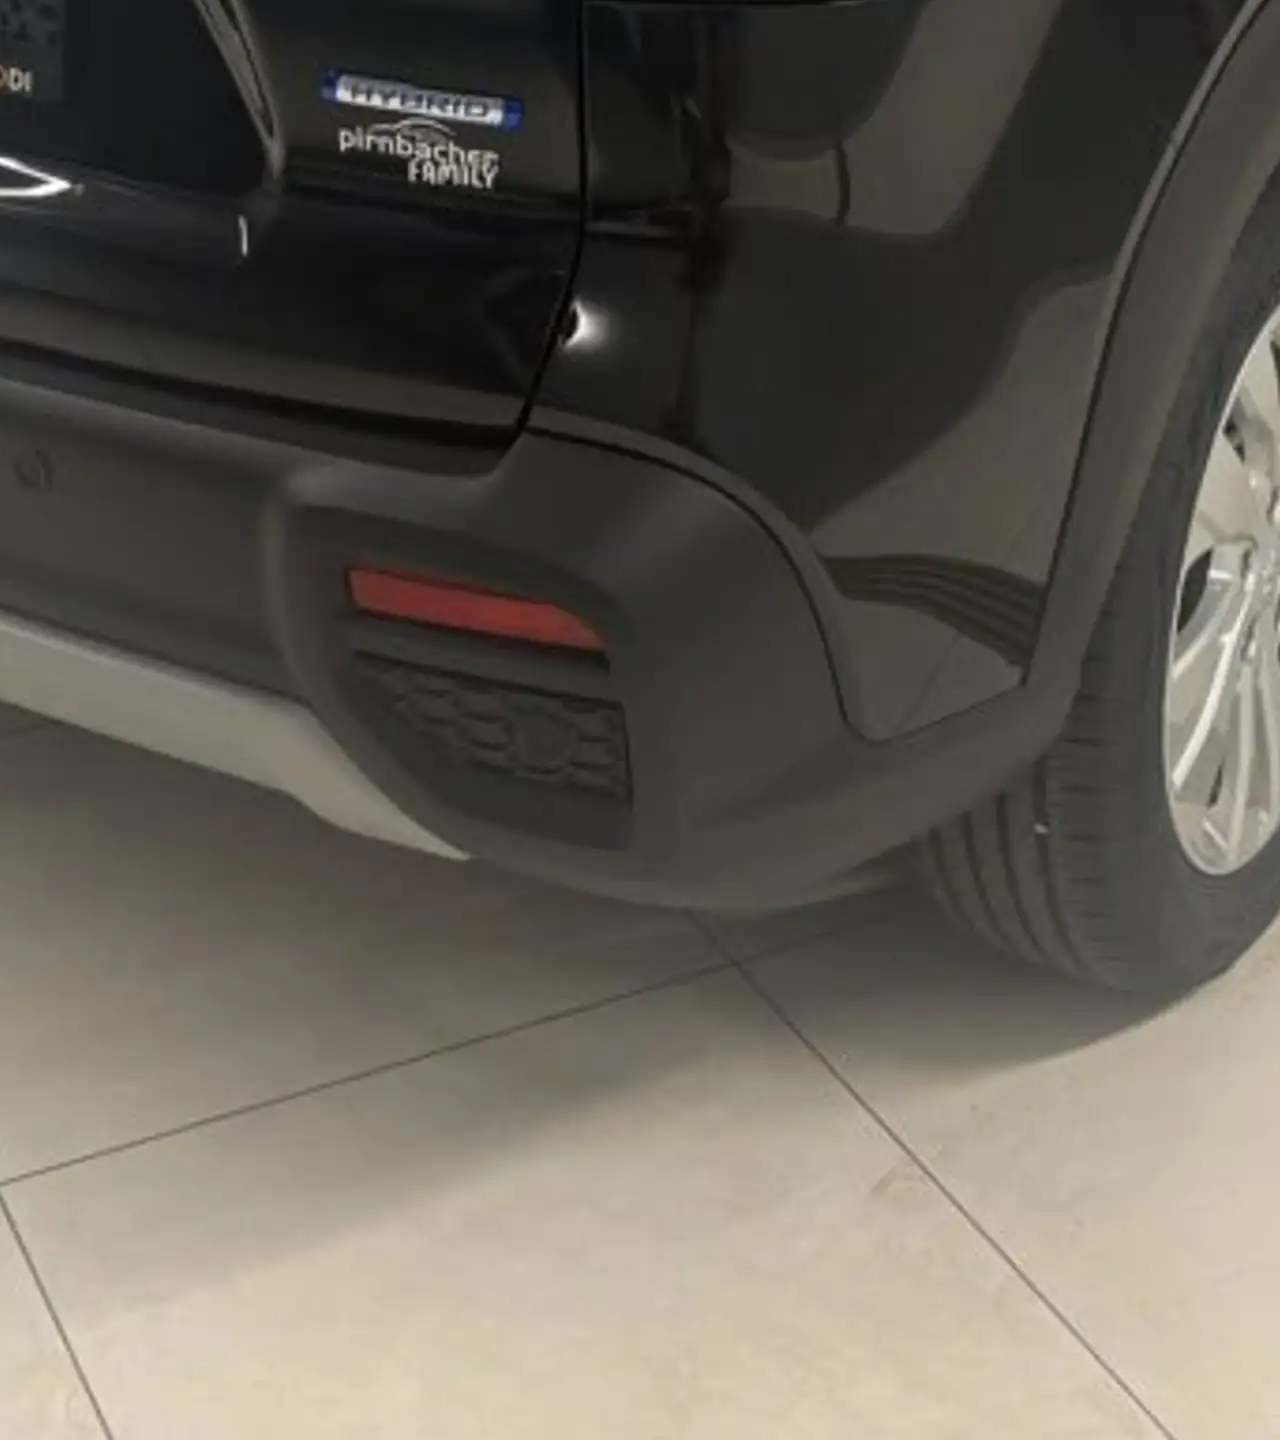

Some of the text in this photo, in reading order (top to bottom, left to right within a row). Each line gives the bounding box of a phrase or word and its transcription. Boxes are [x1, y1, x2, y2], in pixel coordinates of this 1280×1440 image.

[342, 79, 491, 121] HYBRID
[338, 125, 500, 164] pirnbacher
[407, 158, 500, 190] FAMILY
